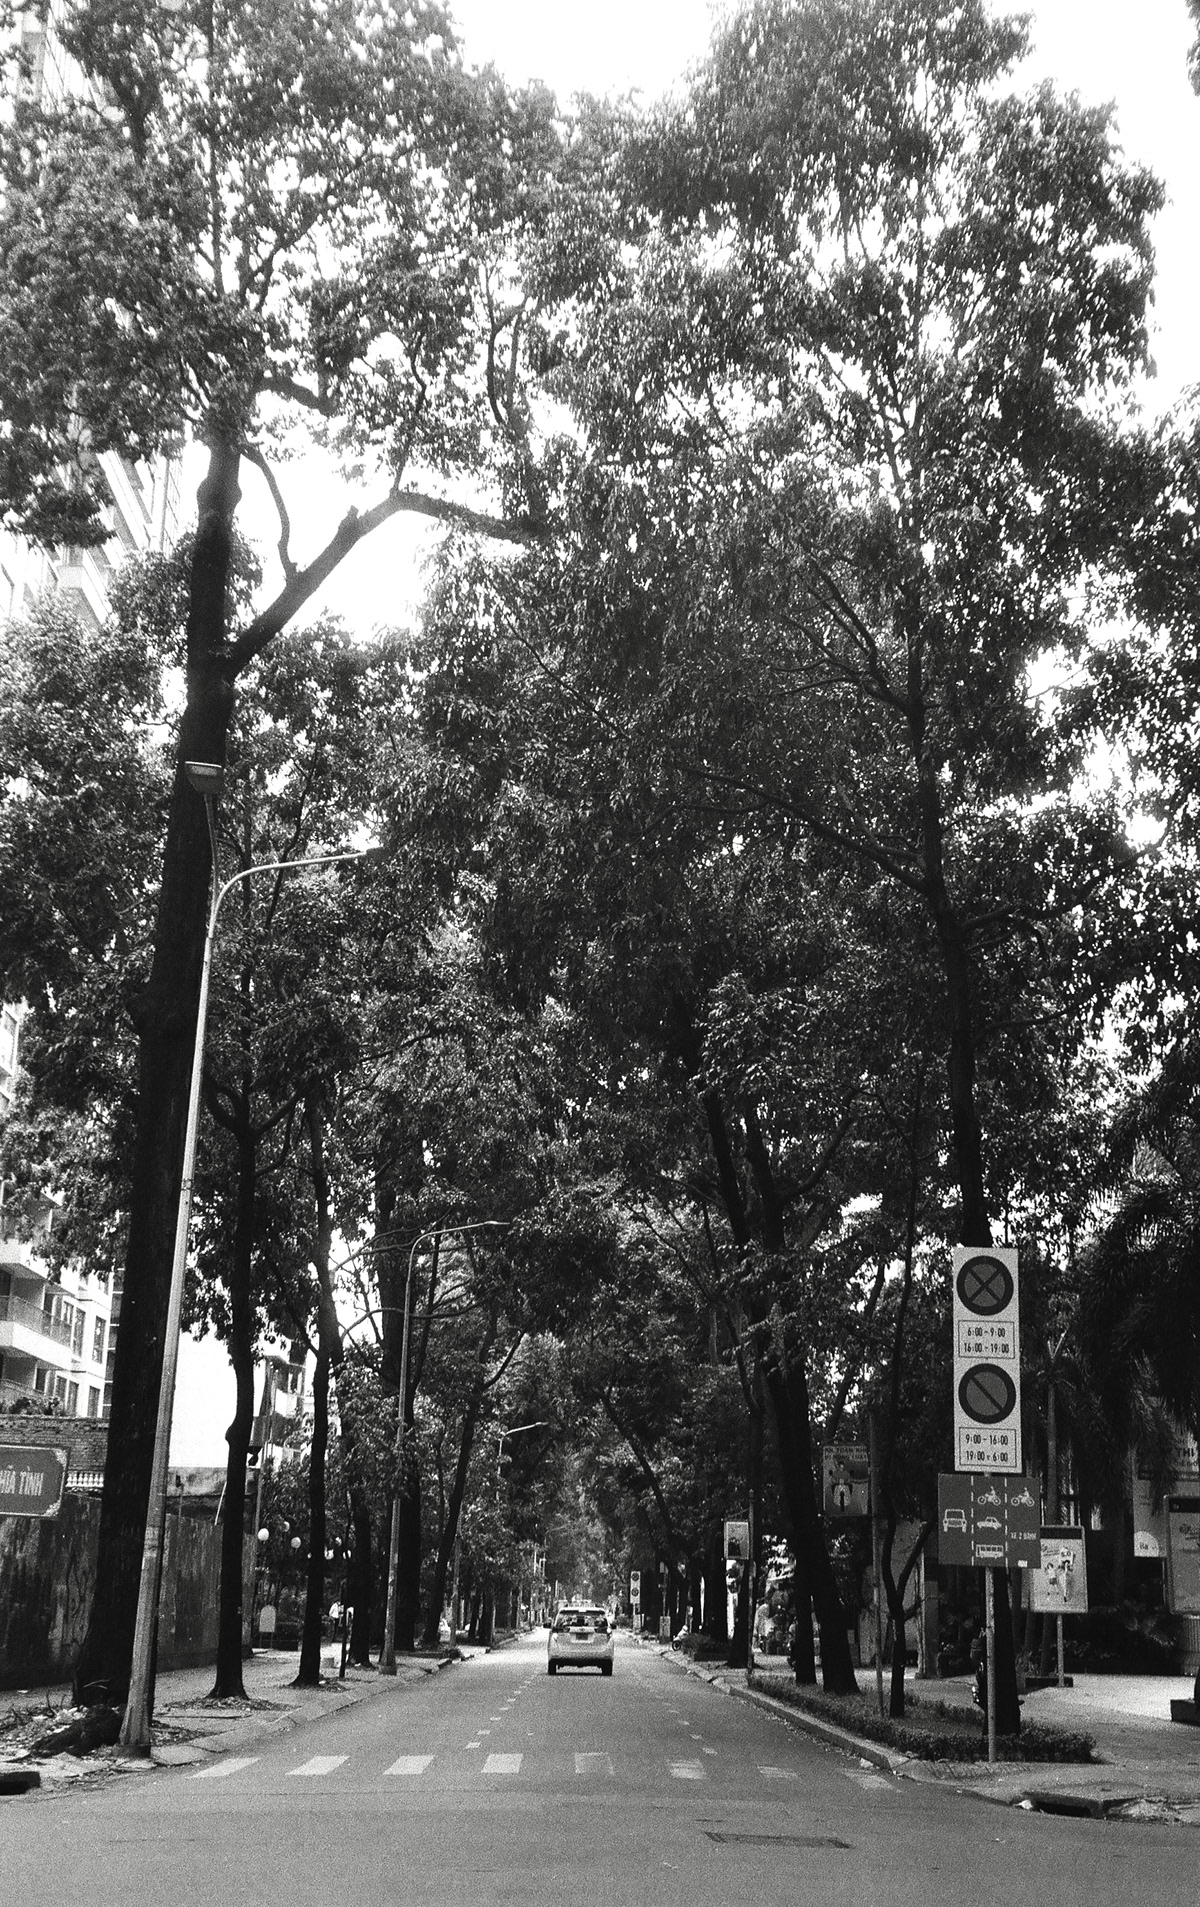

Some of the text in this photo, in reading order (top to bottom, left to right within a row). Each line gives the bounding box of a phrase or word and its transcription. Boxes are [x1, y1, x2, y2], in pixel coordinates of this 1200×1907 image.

[968, 1327, 982, 1336] 6:00
[990, 1327, 1005, 1337] 9:00
[964, 1342, 982, 1352] 16:00
[991, 1343, 1009, 1353] 19:00
[966, 1434, 981, 1444] 9:00
[989, 1435, 1008, 1445] 16:00
[966, 1450, 985, 1460] 19:00
[992, 1452, 1008, 1462] 6:00
